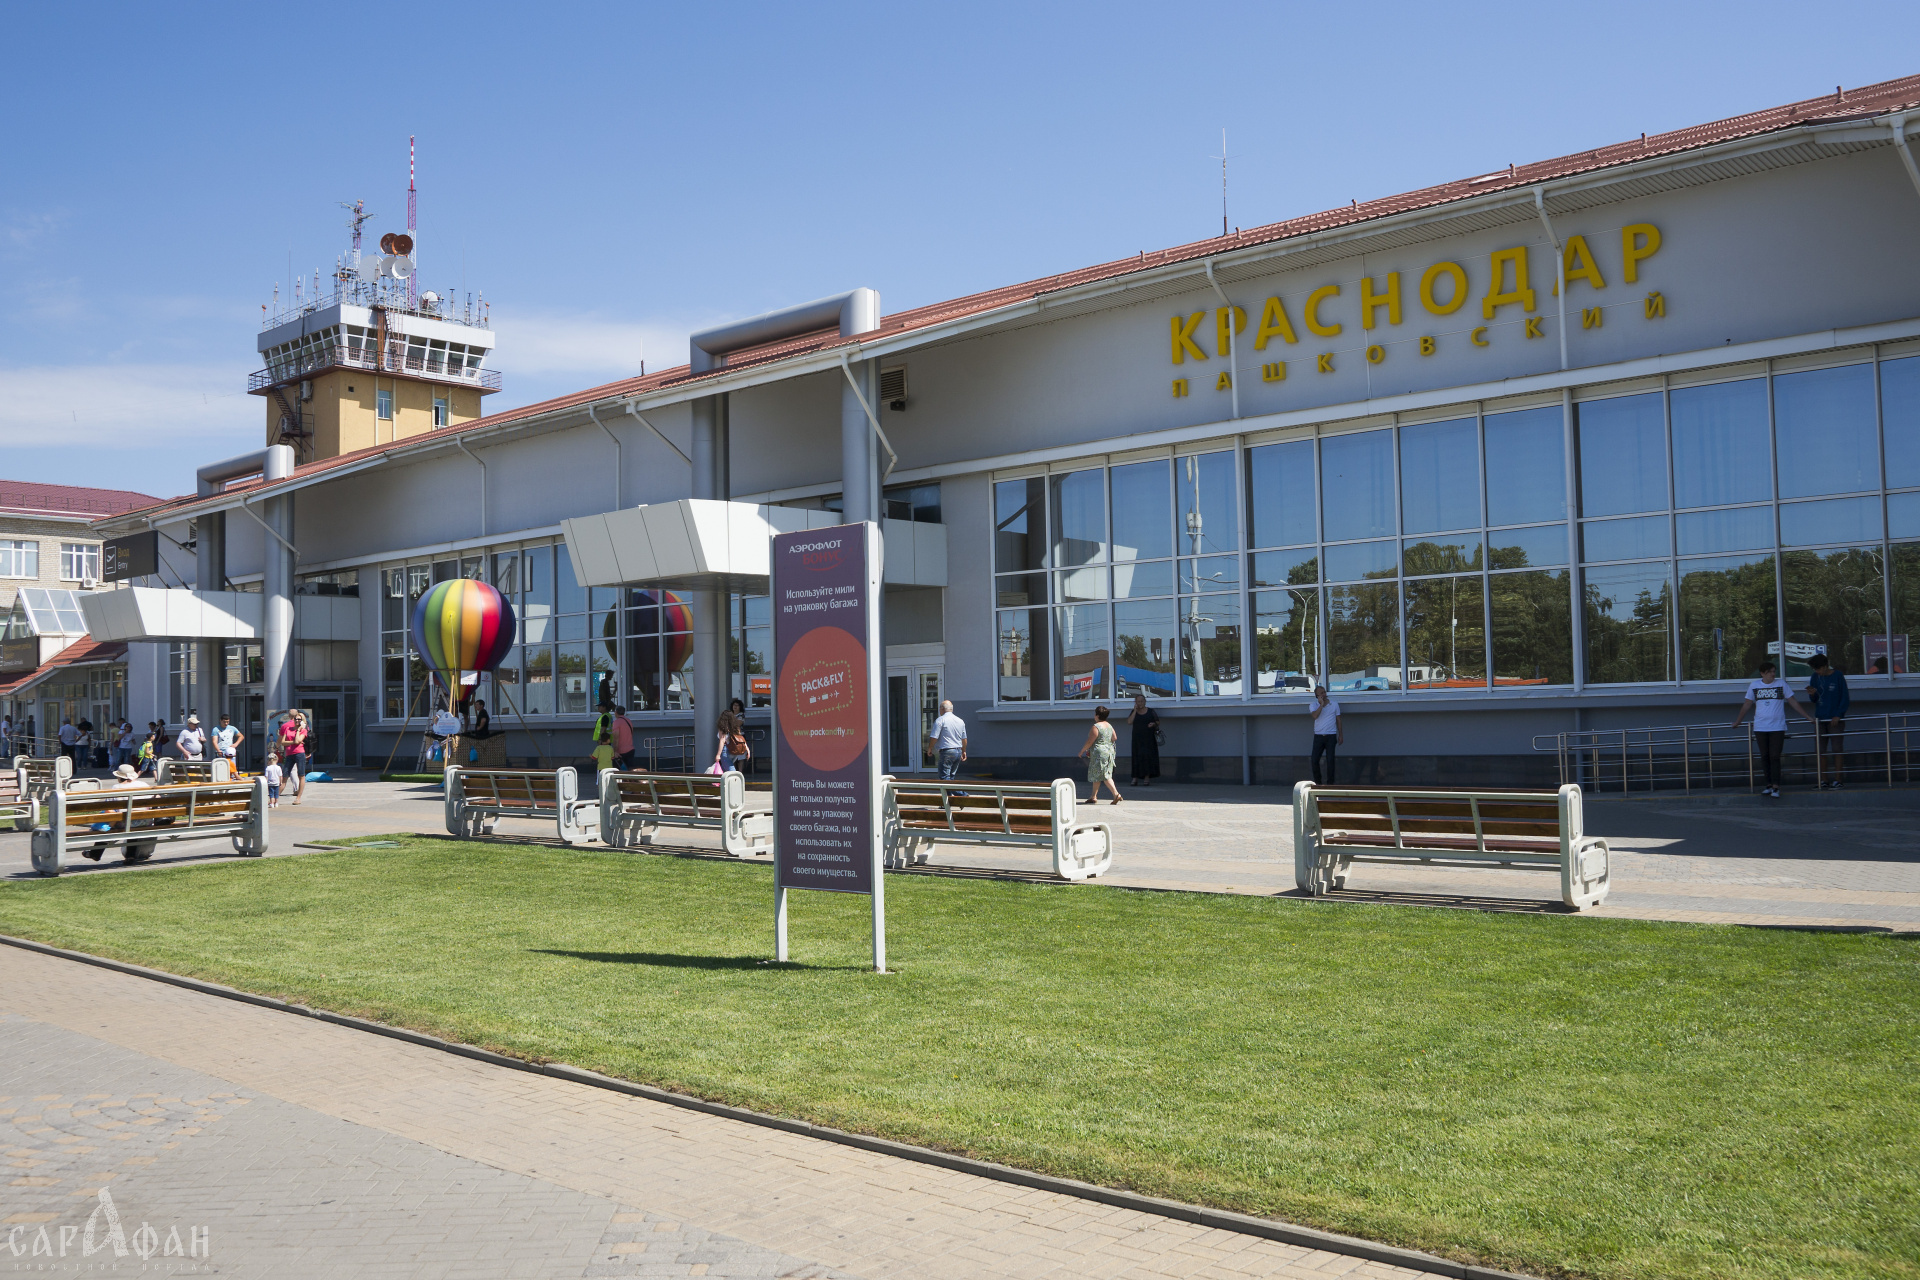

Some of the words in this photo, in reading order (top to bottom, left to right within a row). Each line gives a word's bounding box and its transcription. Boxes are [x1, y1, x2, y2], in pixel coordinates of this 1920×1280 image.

[1170, 223, 1663, 365] КРАСНОДАР
[1172, 291, 1666, 398] ПАШКОВСКИЙ
[789, 540, 842, 554] АЭРОФЛОТ
[803, 549, 842, 565] БОНУС
[117, 561, 128, 571] Entry
[786, 586, 833, 599] Используйте
[834, 585, 855, 595] мили
[783, 605, 793, 613] на
[794, 602, 828, 614] упаковку
[829, 598, 858, 609] багажа
[801, 671, 844, 693] PACK&FLY
[793, 727, 854, 738] www.packandfly.ru
[791, 779, 815, 790] Теперь
[815, 779, 827, 788] Вы
[827, 781, 855, 789] можете
[790, 795, 799, 803] не
[800, 795, 823, 803] только
[824, 796, 857, 805] получать
[821, 810, 854, 820] упаковку
[789, 823, 813, 831] своего
[813, 822, 841, 834] багажа,
[842, 825, 851, 833] но
[795, 838, 842, 847] использовать
[843, 840, 852, 848] их
[797, 852, 806, 860] на
[807, 853, 851, 862] сохранность
[792, 866, 816, 875] своего
[817, 868, 858, 878] имущества.
